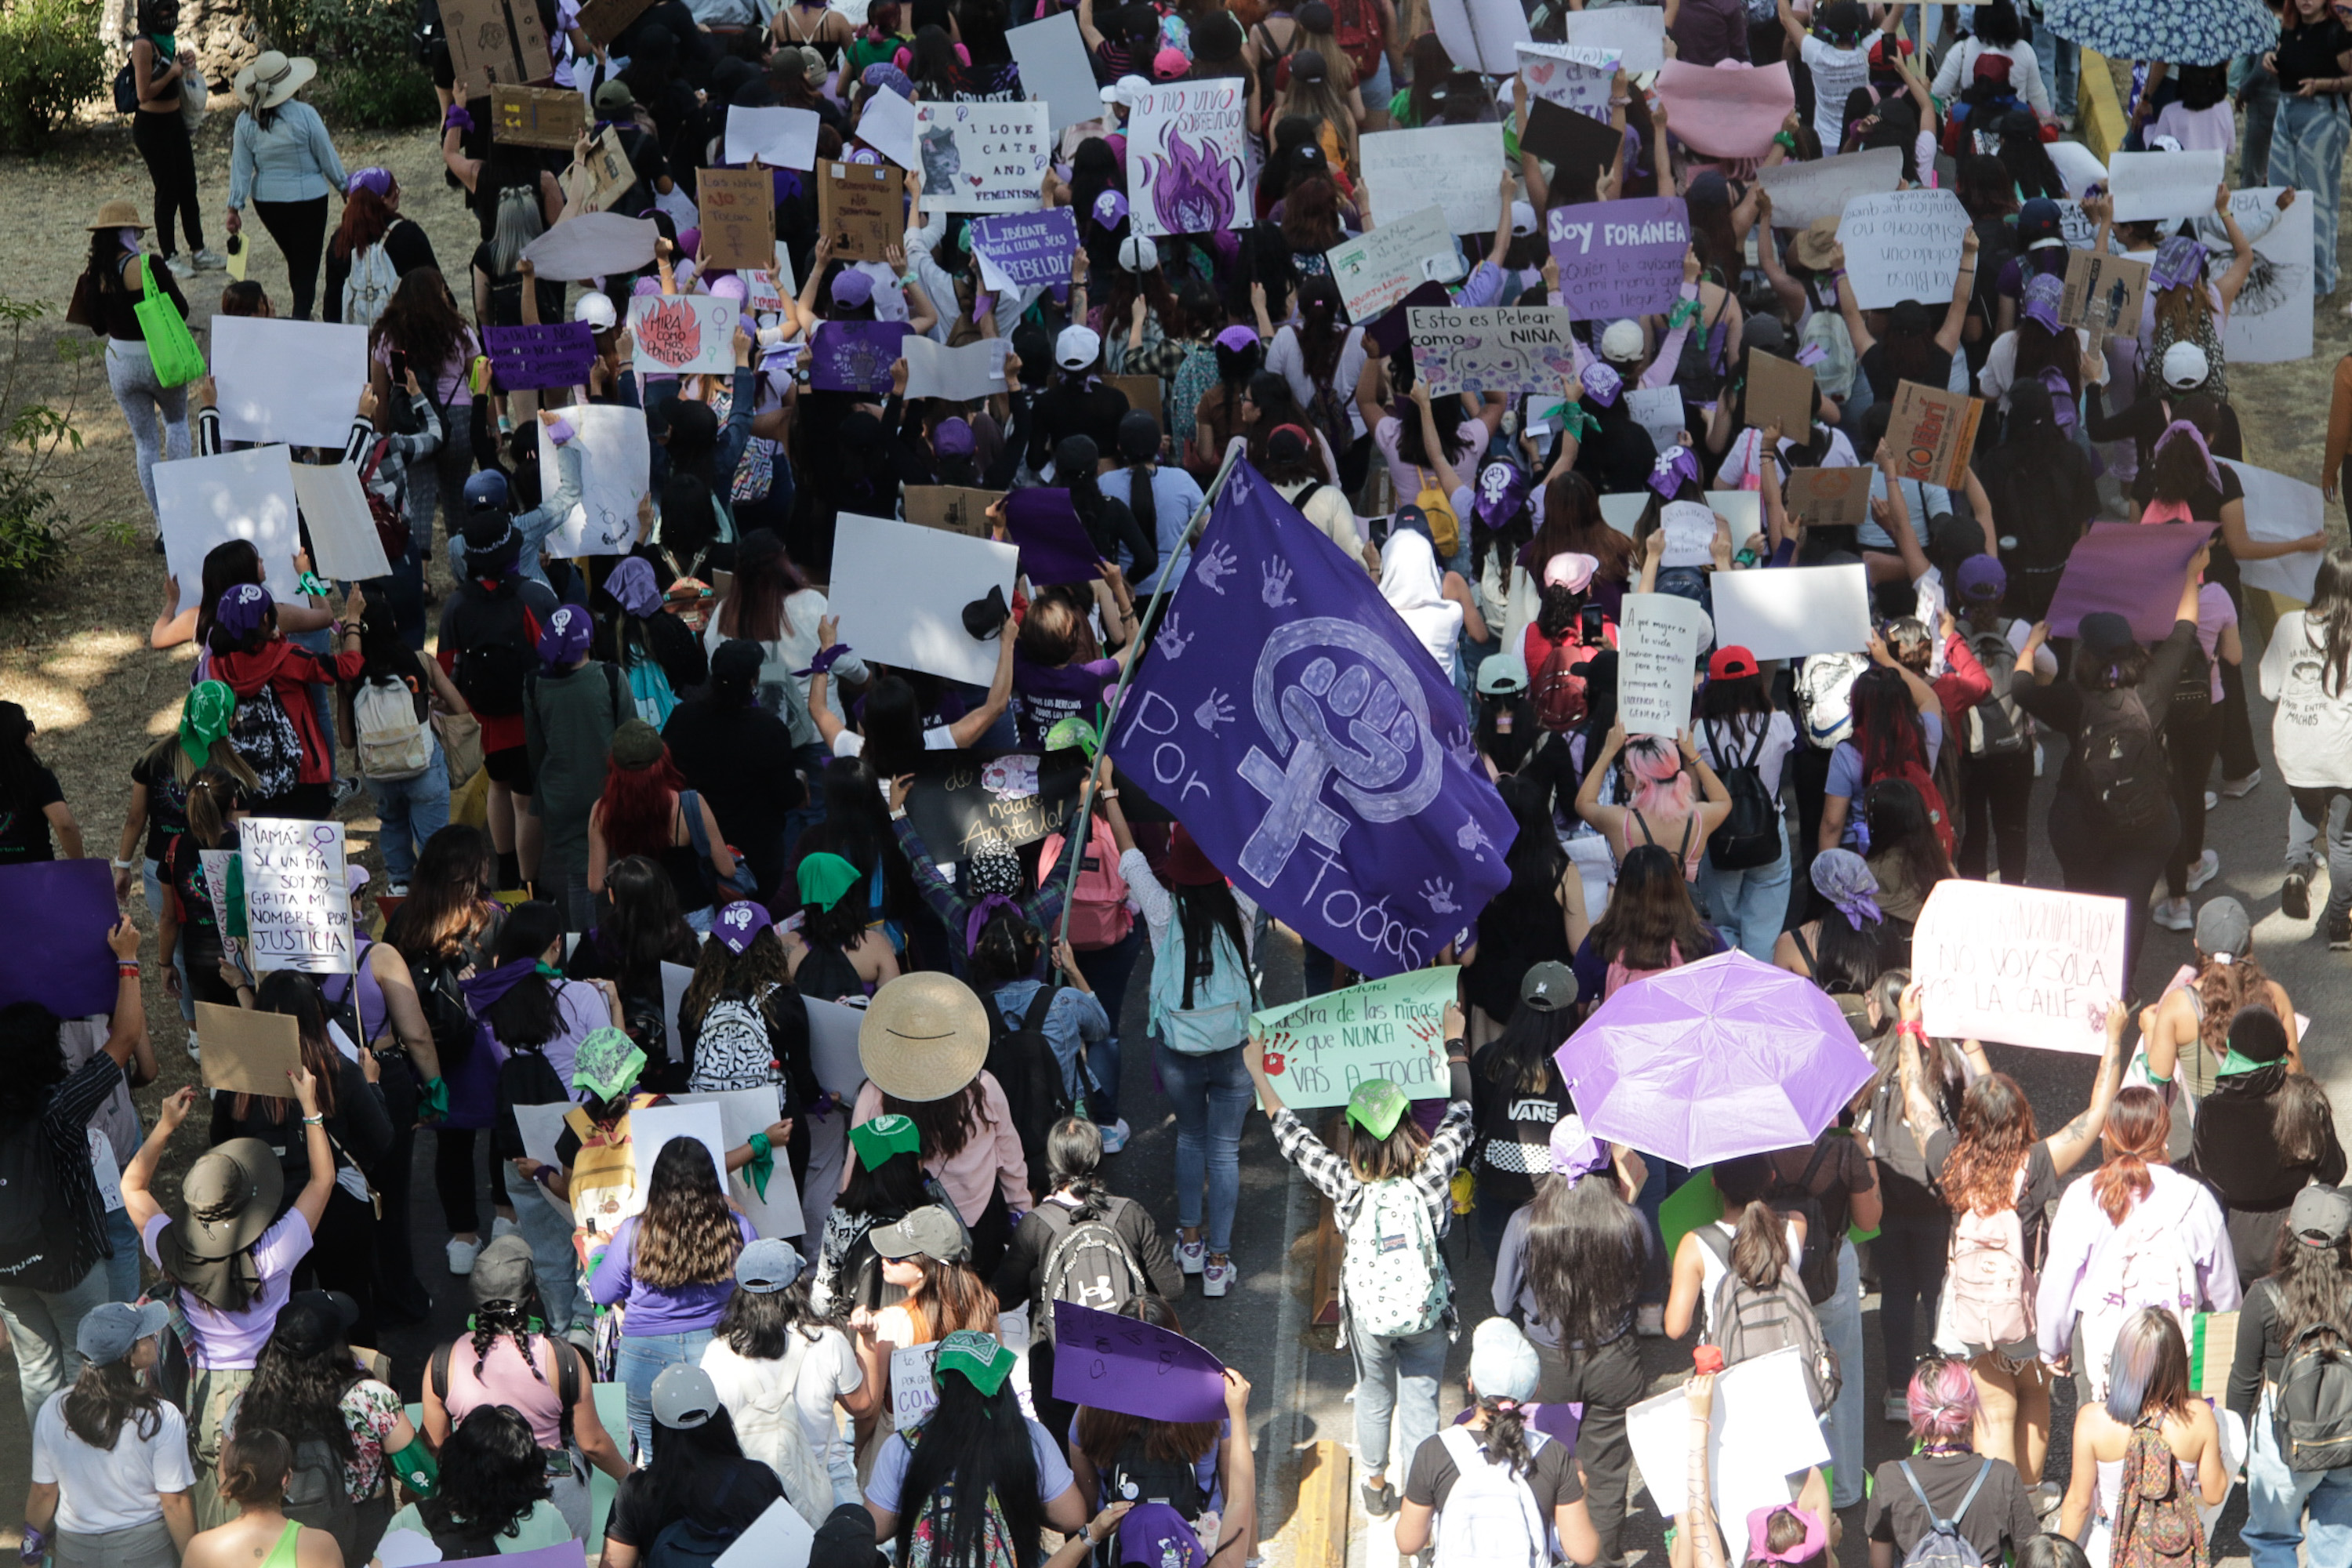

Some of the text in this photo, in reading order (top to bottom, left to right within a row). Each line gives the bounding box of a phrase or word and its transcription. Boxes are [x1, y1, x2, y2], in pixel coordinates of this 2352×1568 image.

[1136, 88, 1234, 117] YO NO VIVO
[969, 123, 1034, 136] I LOVE
[982, 142, 1039, 155] CATS
[993, 165, 1026, 176] AND
[707, 193, 735, 207] NO
[975, 189, 1043, 203] FEMINISM
[1603, 216, 1688, 247] FORÁNEA
[1852, 223, 1875, 238] no
[1045, 234, 1067, 247] SEAS
[1588, 278, 1608, 292] mi
[1589, 299, 1610, 311] no
[650, 314, 681, 331] MIRA
[1413, 310, 1557, 330] Esto es Pelear
[553, 326, 574, 339] NO
[656, 330, 687, 340] COMO
[1413, 328, 1563, 347] como NIÑA
[647, 340, 694, 363] PONEMOS
[664, 339, 684, 350] NOS
[1653, 621, 1677, 636] mujer
[1678, 626, 1687, 635] en
[1652, 637, 1671, 648] vida
[1634, 662, 1668, 676] para que
[1054, 699, 1082, 710] DERECHOS
[1659, 698, 1671, 709] DE
[2303, 701, 2329, 713] ENTRE
[2285, 712, 2319, 727] MACHOS
[1121, 690, 1210, 802] Por
[987, 796, 1044, 819] nadie
[280, 855, 299, 869] UN
[280, 874, 306, 890] SOY
[251, 891, 326, 907] GRITA MI
[326, 909, 348, 925] POR
[2078, 906, 2116, 956] HOY
[1939, 942, 2108, 989] NO VOY SOLA
[1974, 984, 2003, 1014] LA
[1337, 1004, 1356, 1022] de
[1363, 1000, 1388, 1021] las
[1394, 997, 1439, 1018] niñas
[1305, 1022, 1397, 1061] que NUNCA
[1290, 1065, 1330, 1094] VAS
[1345, 1064, 1361, 1091] A
[1507, 1096, 1559, 1124] VANS
